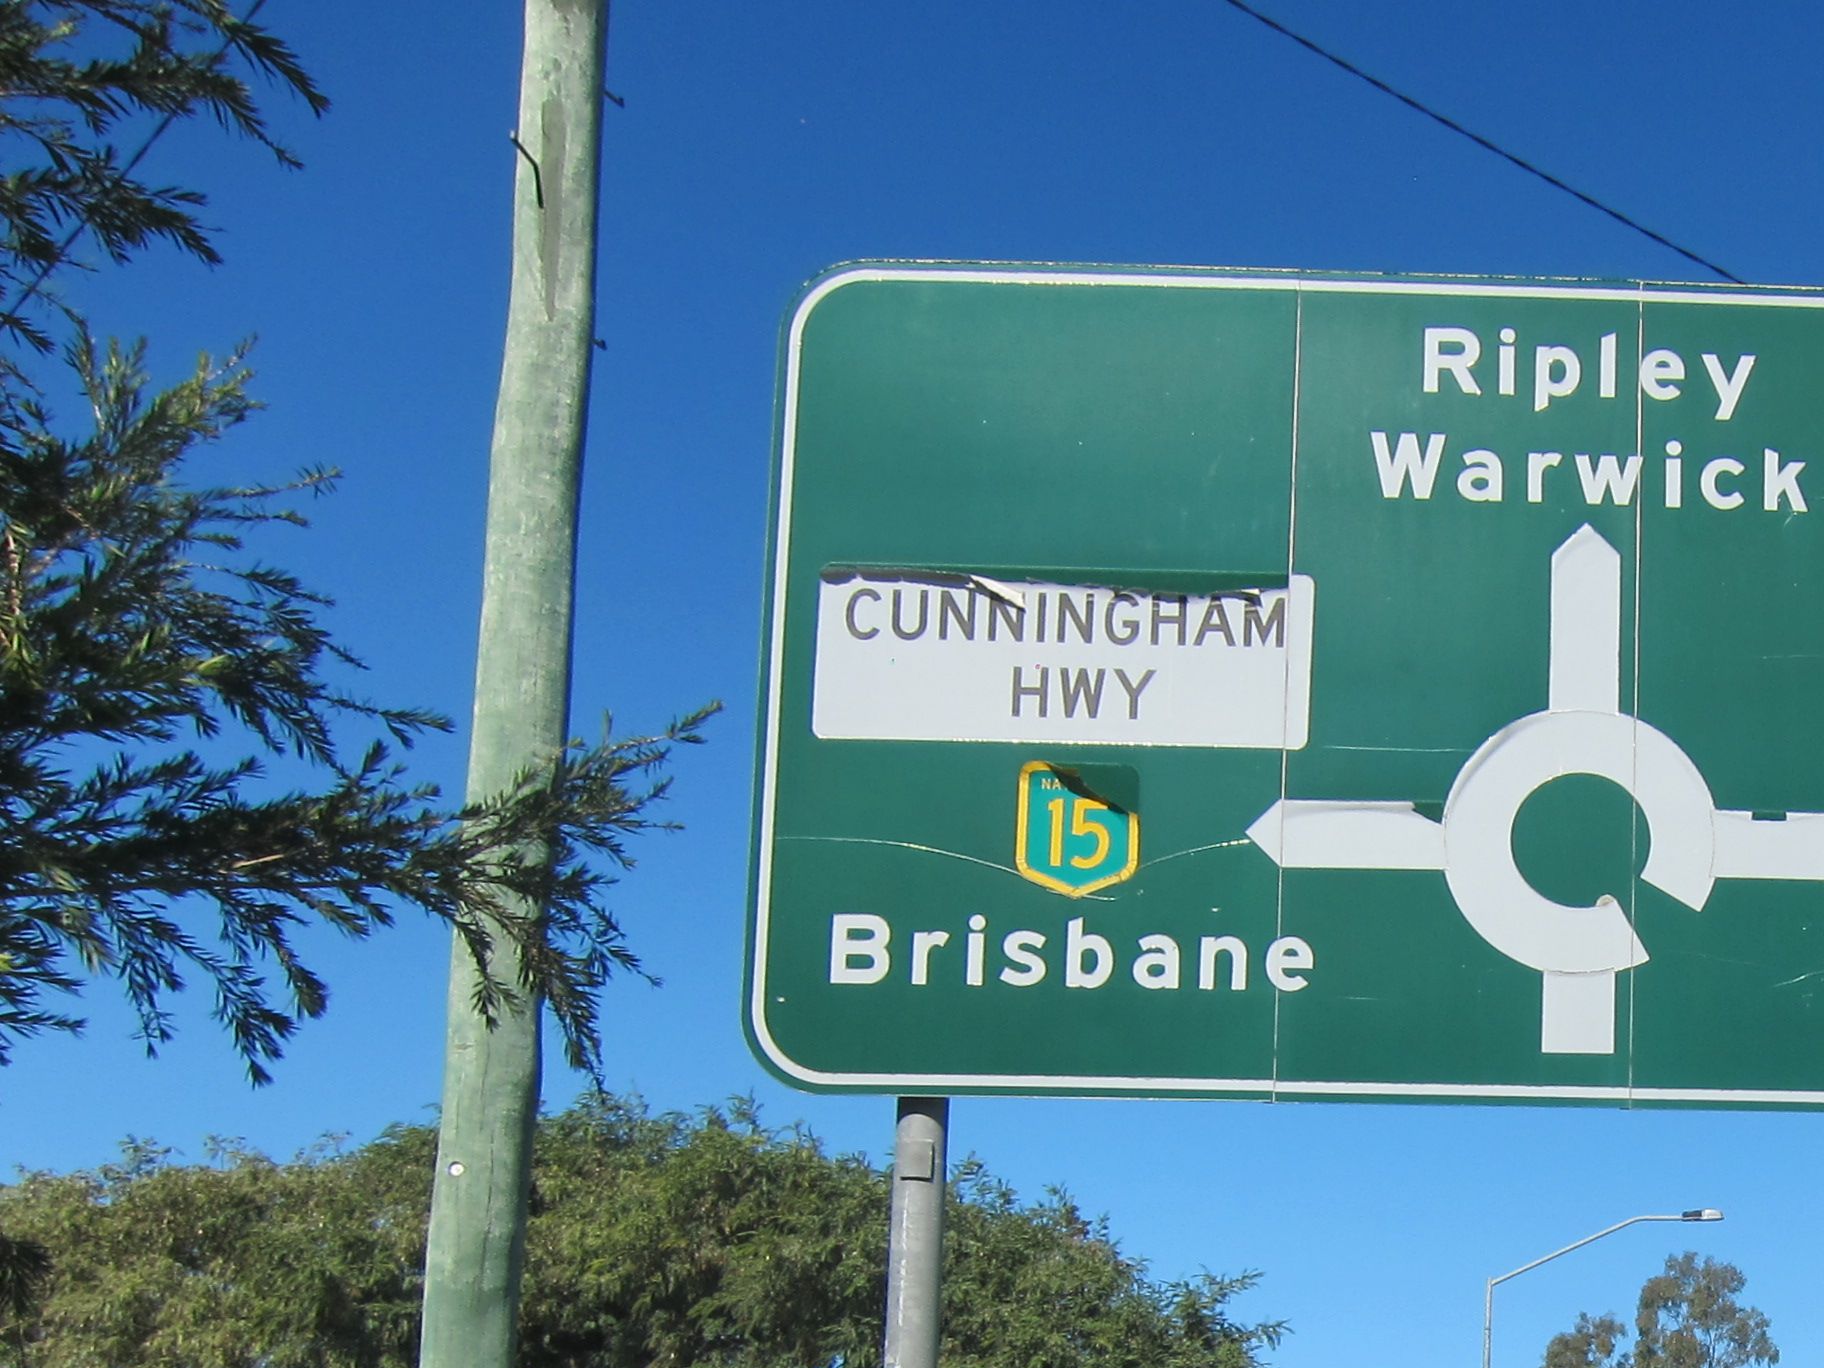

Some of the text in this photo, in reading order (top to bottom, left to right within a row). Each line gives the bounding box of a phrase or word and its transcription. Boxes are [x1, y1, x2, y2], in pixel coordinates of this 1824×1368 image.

[1423, 326, 1756, 420] Ripley
[1371, 431, 1809, 512] Warwick
[845, 588, 1286, 647] CUNNINGHAM
[1011, 666, 1157, 720] HWY
[1047, 797, 1111, 869] 15
[830, 913, 1314, 992] Brisbane
